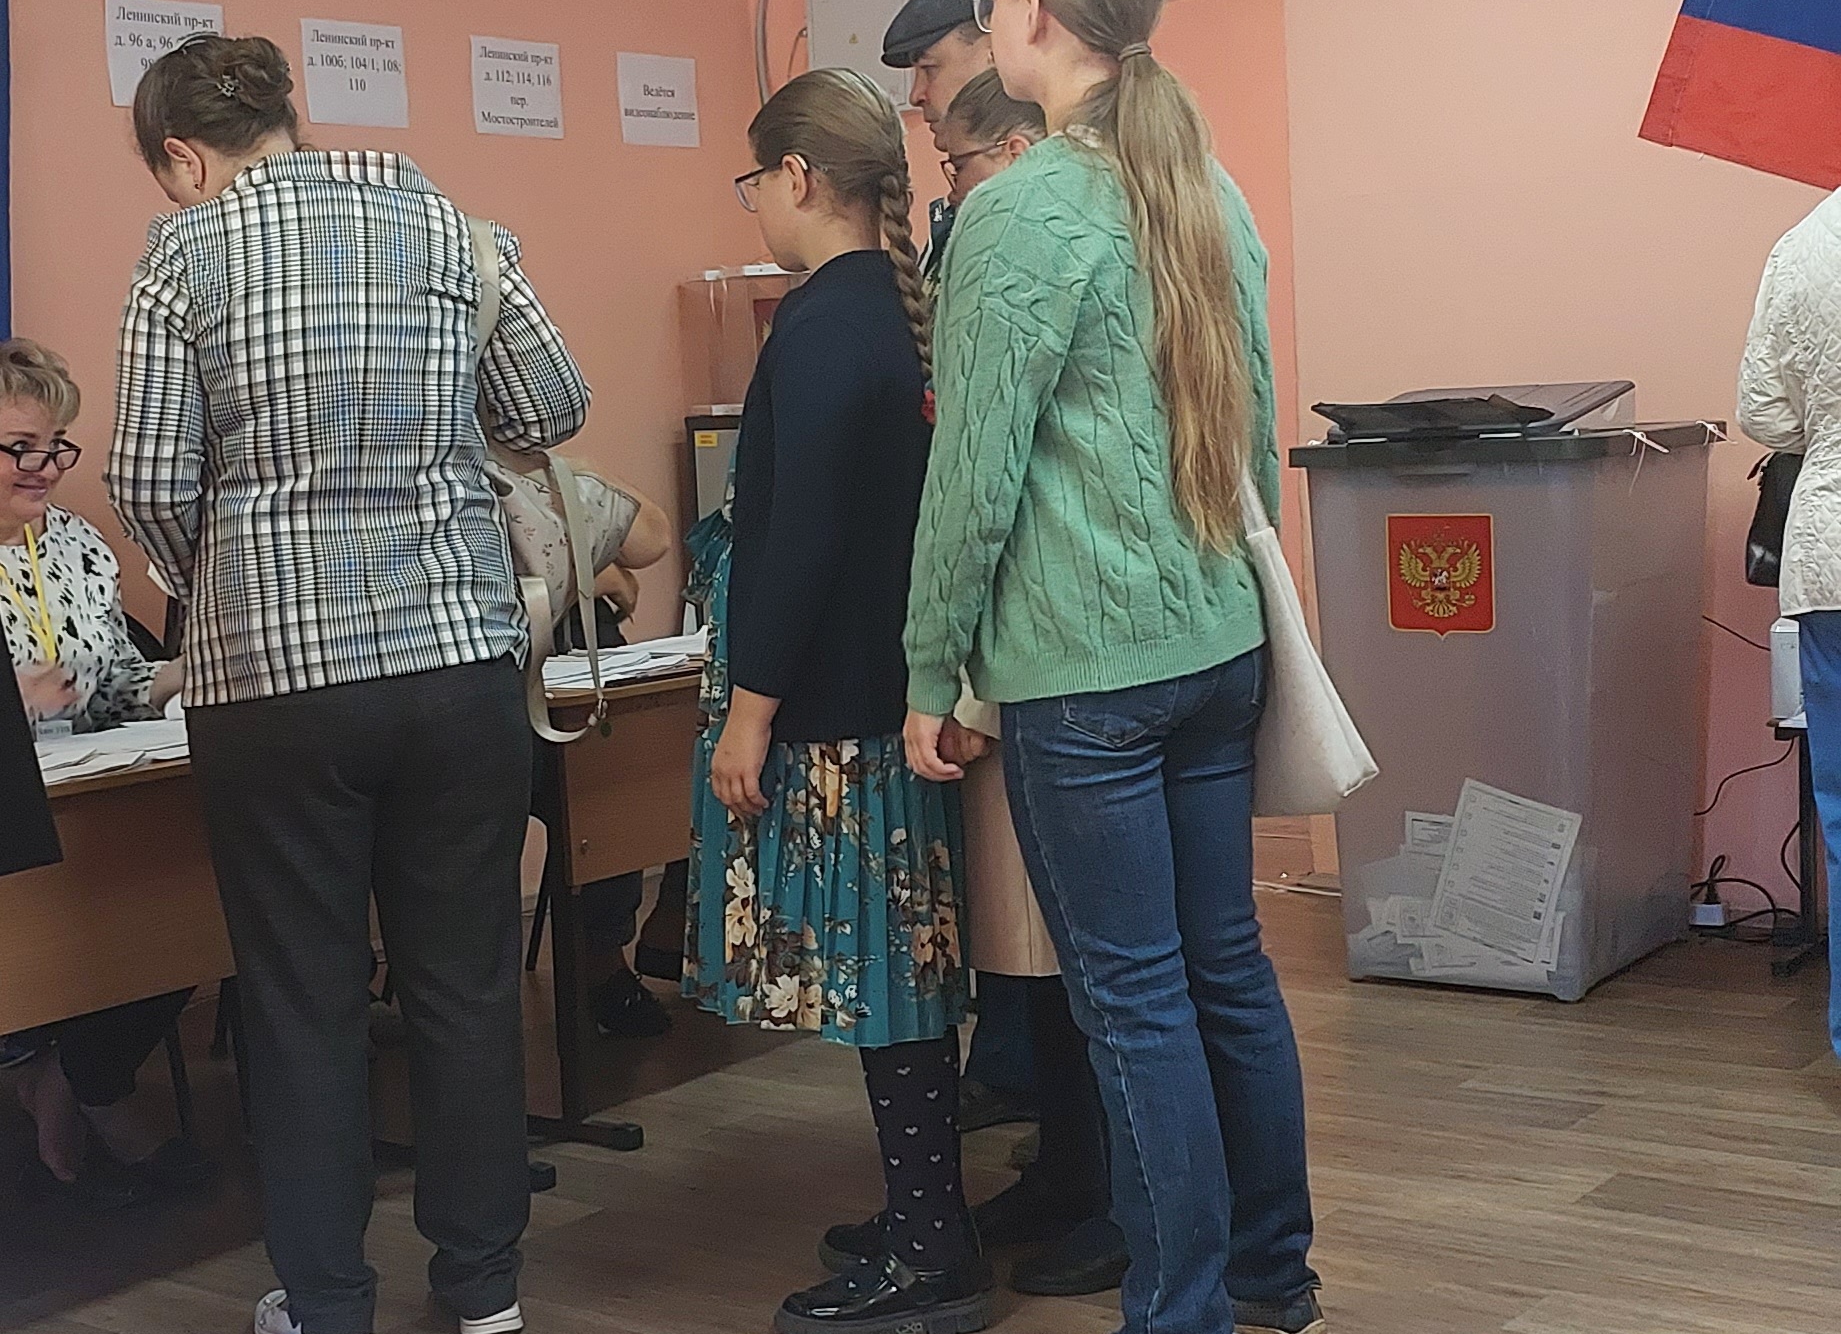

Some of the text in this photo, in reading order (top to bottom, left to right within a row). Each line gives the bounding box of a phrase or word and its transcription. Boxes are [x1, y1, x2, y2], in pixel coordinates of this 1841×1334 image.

[116, 6, 214, 30] Ленинский пр-кт
[114, 33, 174, 51] д. 96 а; 96
[311, 29, 395, 51] Ленинский пр-кт
[479, 46, 553, 66] Ленинский пр-кт
[382, 58, 401, 74] 108;
[349, 78, 366, 91] 110
[536, 73, 552, 86] 116
[510, 96, 529, 109] пер.
[481, 110, 559, 129] Мостостроителей
